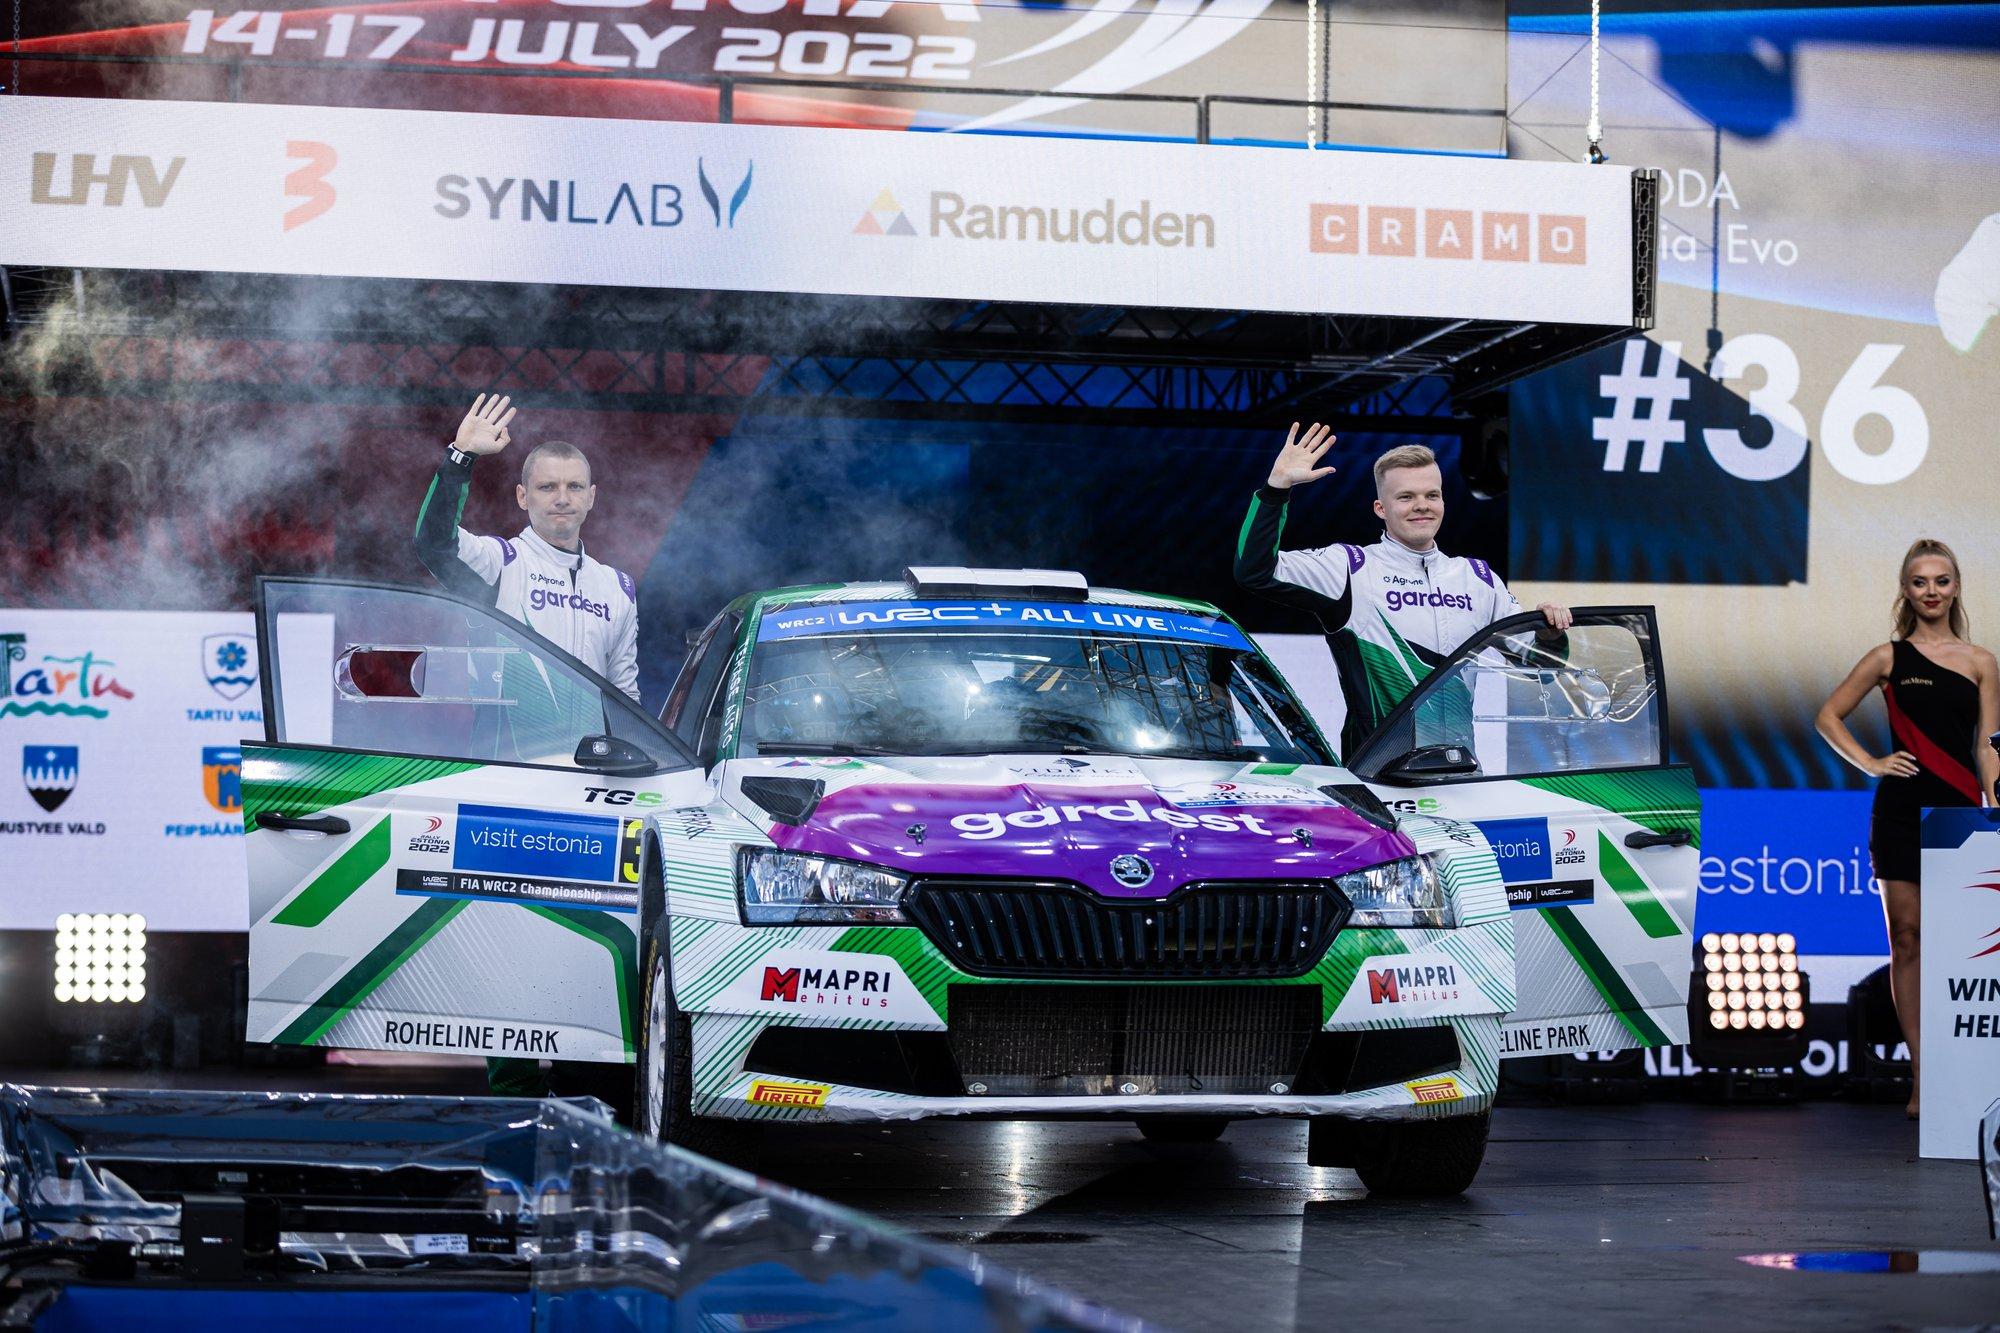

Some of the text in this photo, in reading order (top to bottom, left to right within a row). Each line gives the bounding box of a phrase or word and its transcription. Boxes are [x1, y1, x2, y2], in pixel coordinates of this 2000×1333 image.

[182, 8, 425, 59] 14-17
[451, 18, 695, 69] JULY
[713, 27, 978, 79] 2022
[29, 151, 187, 209] LHV
[929, 190, 1217, 249] Ramudden
[1315, 209, 1581, 259] CRAMO
[1727, 223, 1799, 266] Evo
[1592, 333, 1931, 486] #36
[530, 588, 611, 622] gardest
[1385, 586, 1474, 612] gardest
[776, 616, 827, 631] WRC2
[1020, 607, 1085, 625] ALL
[1092, 610, 1169, 631] LIVE
[186, 709, 262, 723] TARTU VAL
[721, 704, 740, 749] AUTO
[584, 786, 664, 807] TGS
[67, 823, 106, 836] VALD
[165, 822, 245, 837] PEIPSIÄÄR
[950, 800, 1274, 841] gardest
[408, 843, 450, 854] 2022
[410, 837, 451, 845] ESTONIA
[470, 825, 603, 856] visit estonia
[1492, 838, 1541, 859] stonia
[1554, 855, 1586, 865] 2022
[460, 877, 480, 891] FIA
[483, 879, 517, 894] WRC2
[520, 882, 603, 903] Championship
[802, 967, 891, 993] MAPRI
[1398, 965, 1457, 988] MAPRI
[800, 992, 889, 1008] ehitus
[1400, 990, 1460, 1002] ehitus
[384, 1020, 560, 1054] ROHELINE PARK
[1547, 1024, 1591, 1049] PARK
[752, 1083, 823, 1106] PIRELLI
[1411, 1083, 1460, 1103] PIRELLI
